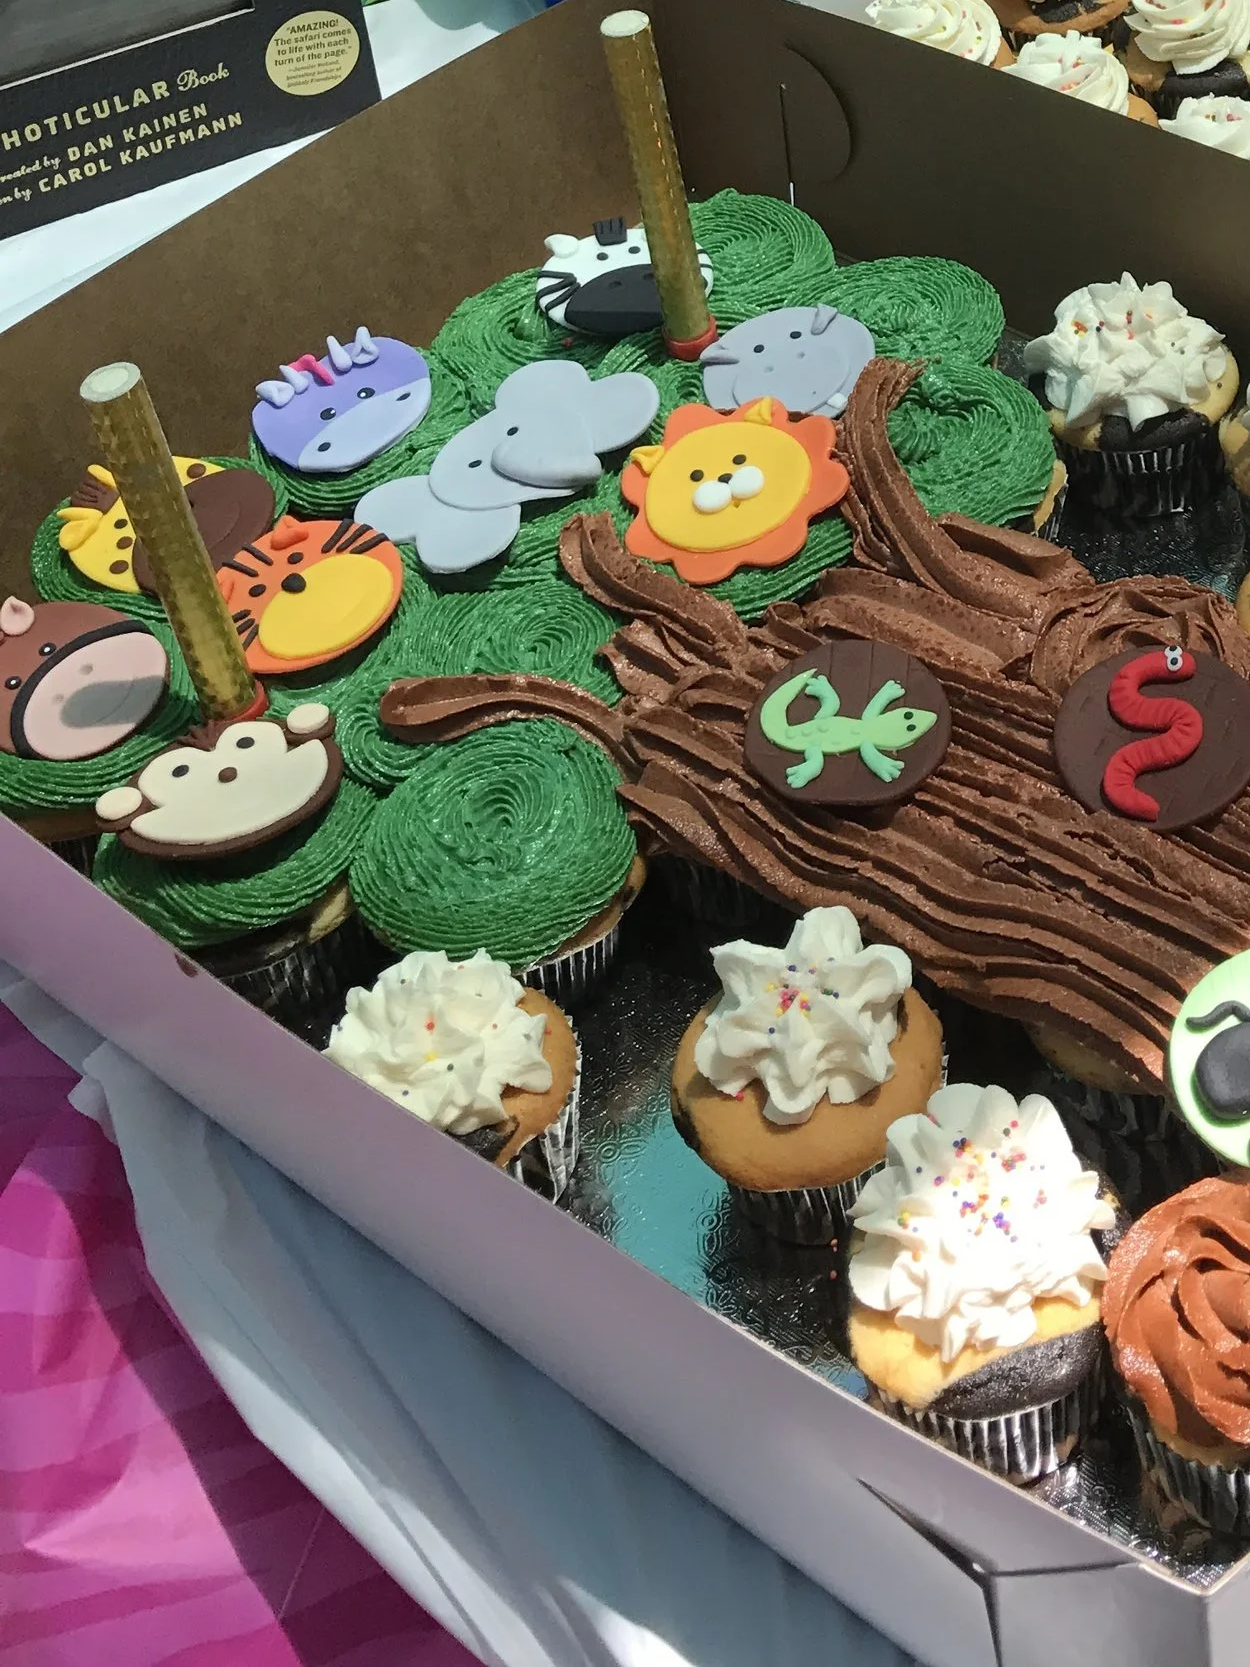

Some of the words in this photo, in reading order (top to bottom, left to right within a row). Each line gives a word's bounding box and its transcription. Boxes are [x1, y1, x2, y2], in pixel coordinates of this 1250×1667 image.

[274, 38, 292, 47] The
[294, 33, 320, 43] safari
[322, 28, 351, 39] comes
[289, 45, 304, 54] life
[305, 42, 325, 52] with
[327, 37, 349, 48] each
[274, 57, 294, 67] turn
[296, 53, 305, 63] of
[307, 52, 322, 61] the
[2, 80, 170, 151] HOTICULAR
[176, 62, 230, 92] Book
[14, 187, 33, 202] by
[38, 158, 112, 193] CAROL
[119, 111, 244, 166] KAUFMANN
[43, 155, 61, 170] by
[67, 134, 114, 162] DAN
[122, 102, 209, 143] KAINEN
